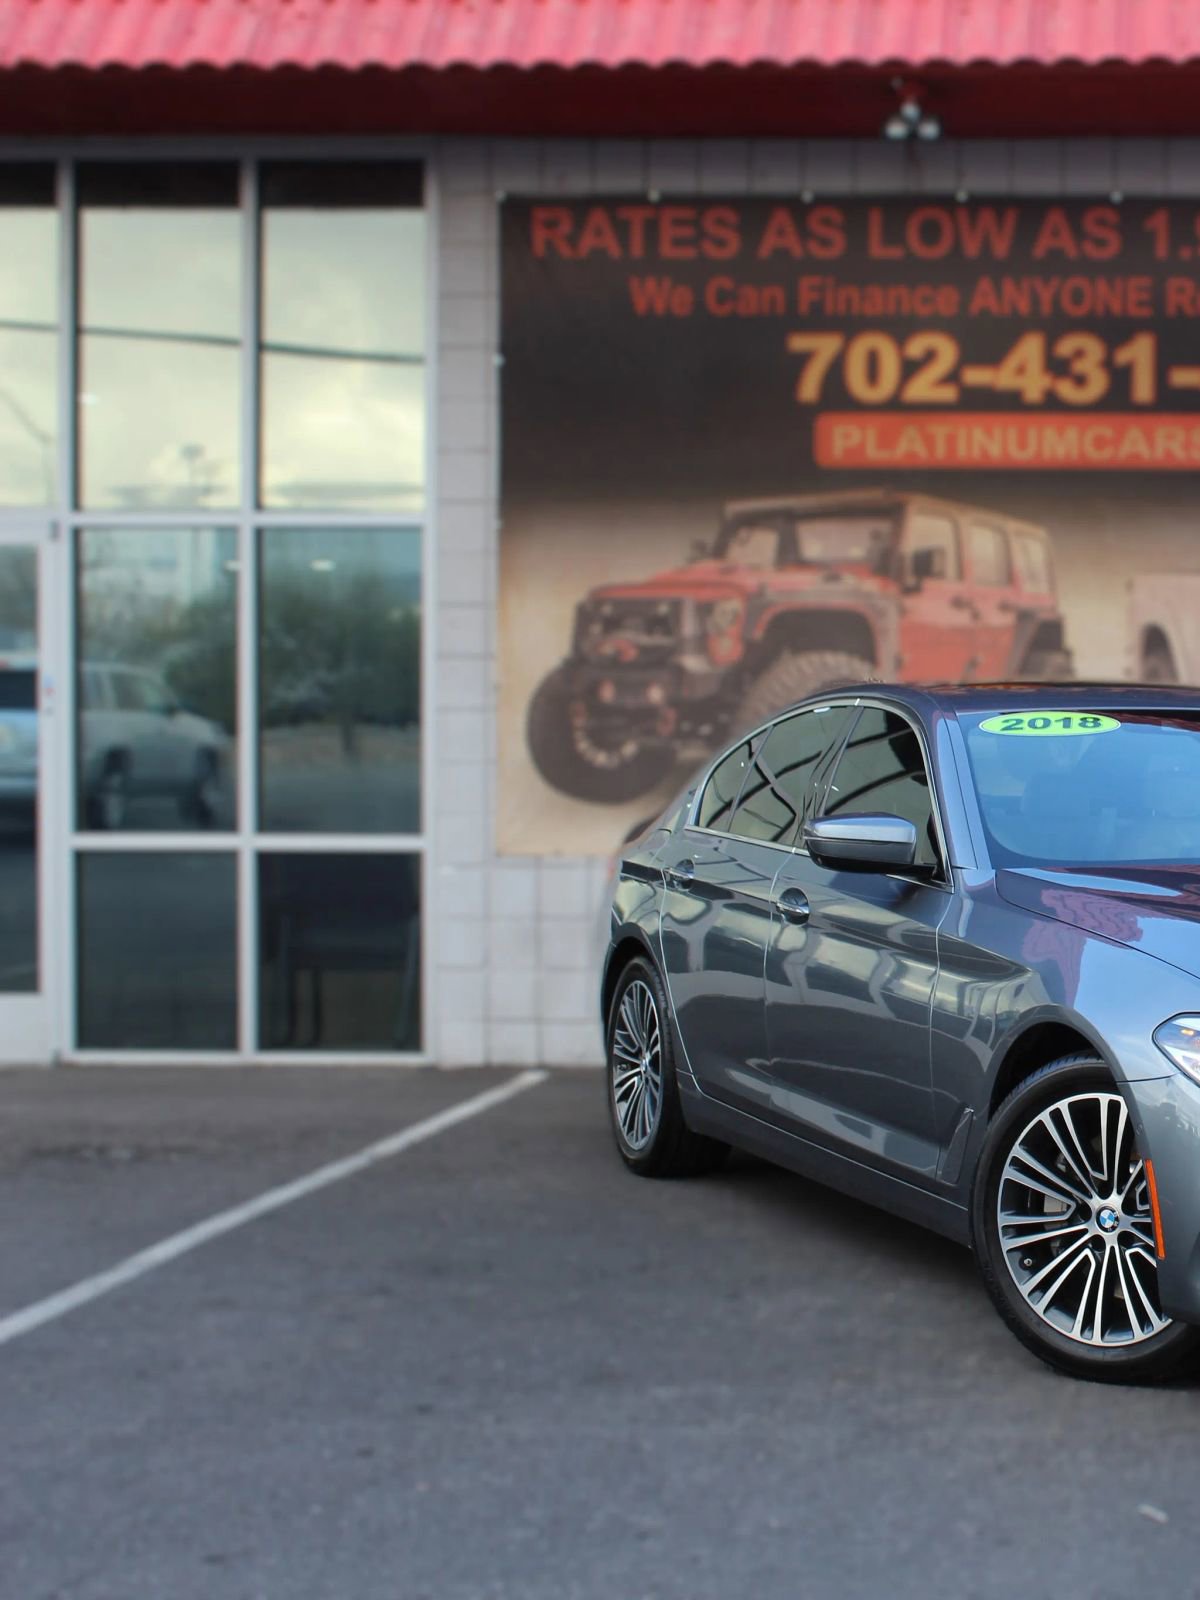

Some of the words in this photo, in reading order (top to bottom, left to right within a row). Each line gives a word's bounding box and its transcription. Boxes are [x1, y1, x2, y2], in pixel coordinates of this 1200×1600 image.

[531, 206, 741, 261] RATES
[758, 206, 847, 260] AS
[868, 207, 1018, 261] LOW
[1032, 207, 1121, 262] AS
[629, 276, 694, 317] We
[705, 276, 785, 317] Can
[799, 276, 960, 317] Finance
[968, 276, 1152, 318] ANYONE
[1000, 716, 1102, 731] 2018
